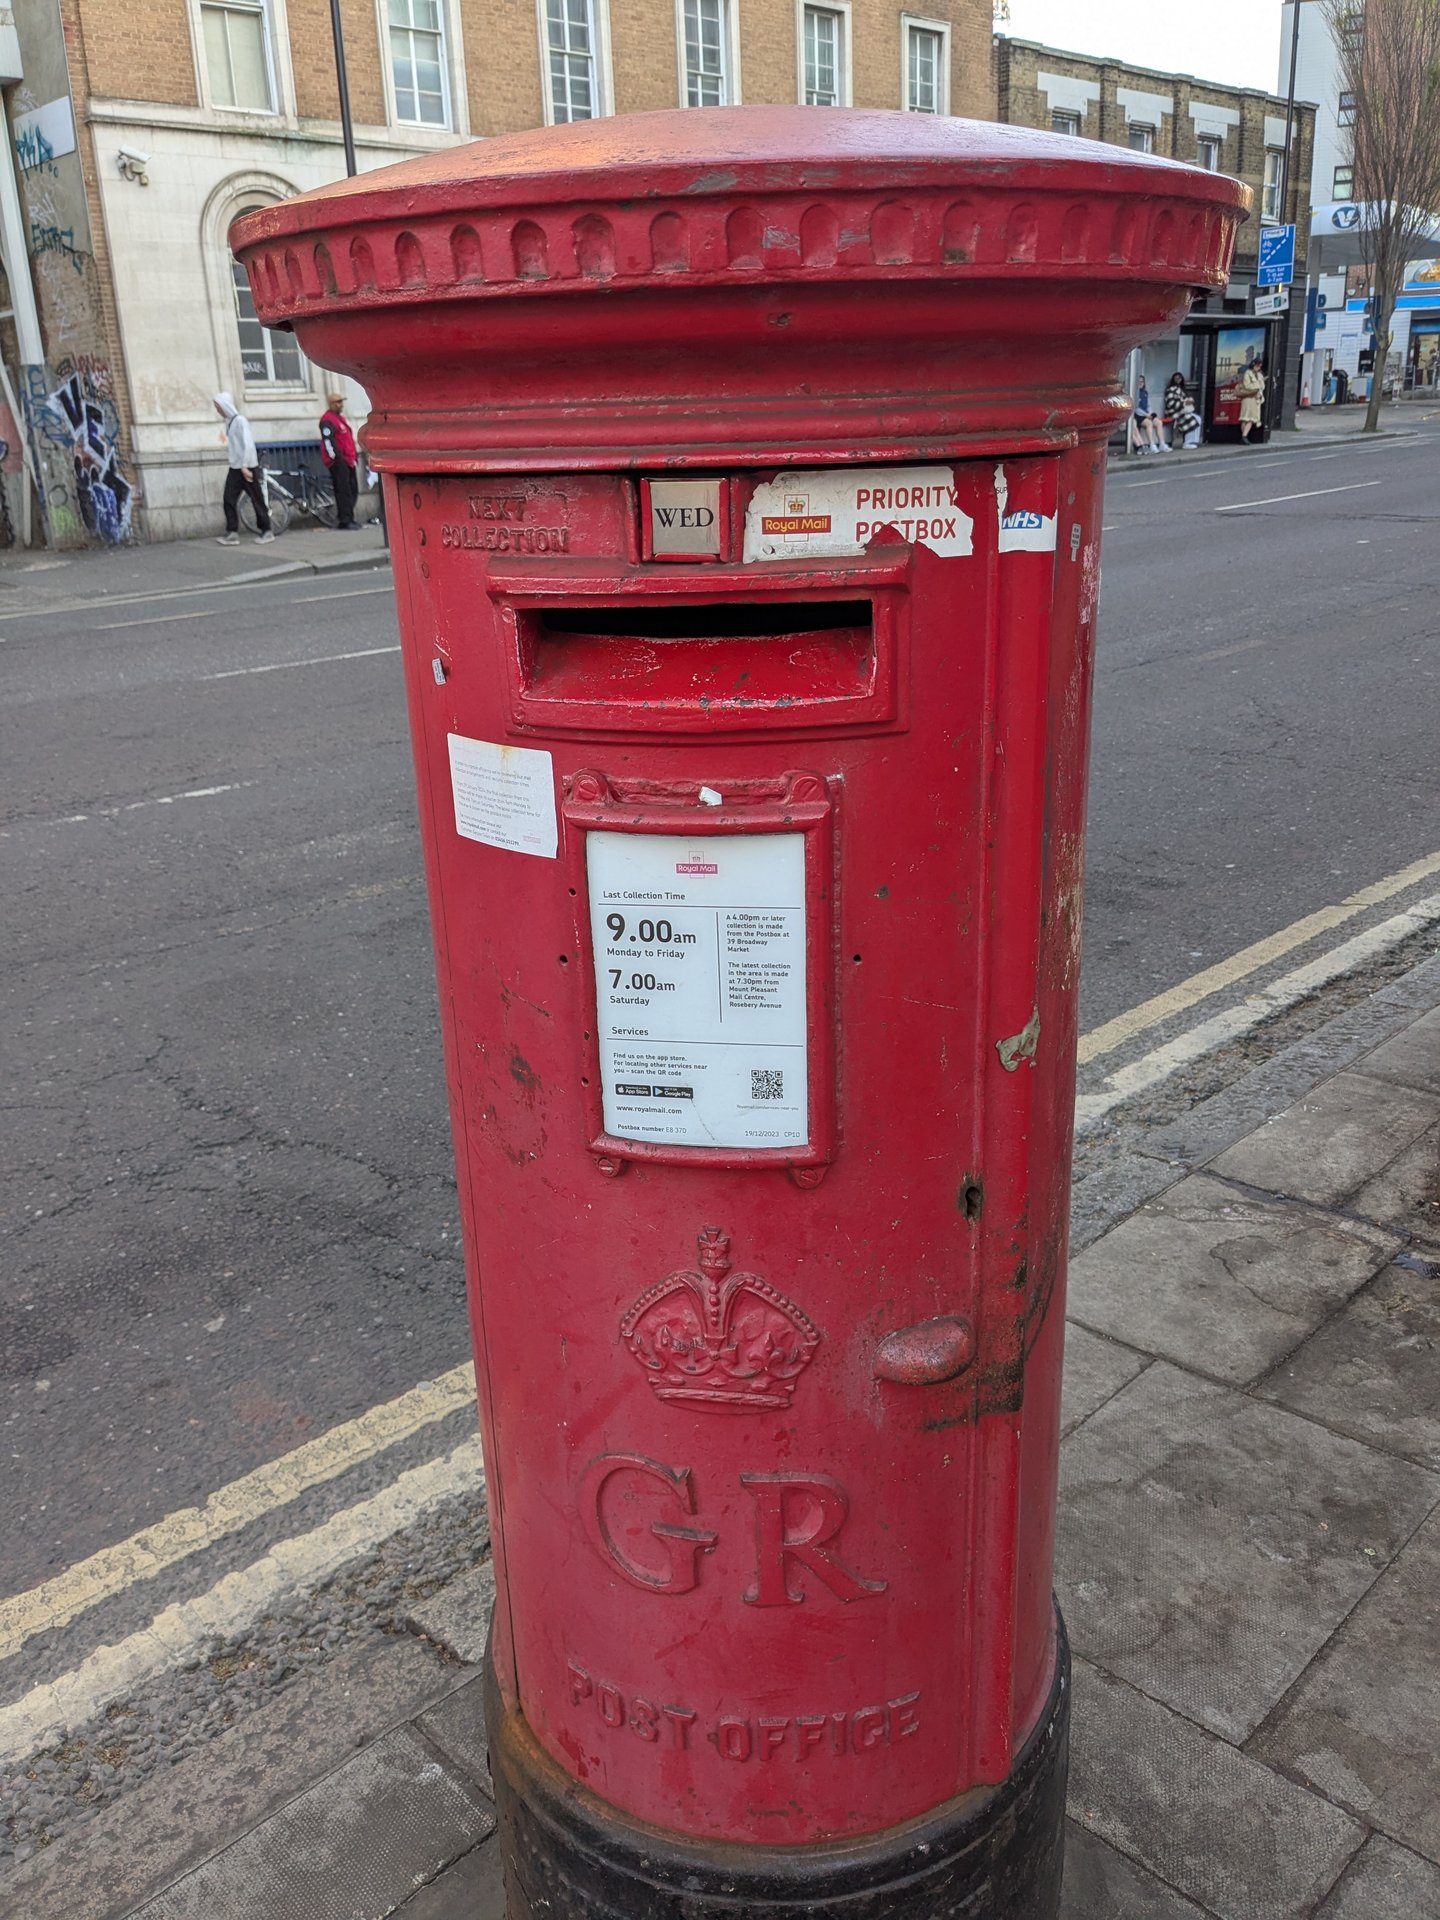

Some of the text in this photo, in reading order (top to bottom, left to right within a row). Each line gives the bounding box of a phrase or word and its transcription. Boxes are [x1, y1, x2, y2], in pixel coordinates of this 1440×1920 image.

[856, 485, 957, 510] PRIORITY
[468, 495, 527, 521] NEXT
[655, 507, 714, 528] WED
[765, 518, 828, 533] Royal Mail
[1002, 511, 1040, 528] NHS
[441, 524, 570, 553] COLLECTION
[856, 518, 957, 542] POTBOX
[678, 864, 699, 873] Royal
[603, 891, 686, 900] Last Collection Time
[732, 914, 760, 922] 4.00pm
[607, 913, 696, 944] 9.00am
[607, 948, 685, 960] Monday to Friday
[609, 969, 675, 991] 7.00am
[610, 995, 650, 1006] Saturday
[611, 1026, 649, 1036] Services
[616, 1106, 682, 1114] www.royalmail.com
[567, 1658, 921, 1762] POST OFFICE
